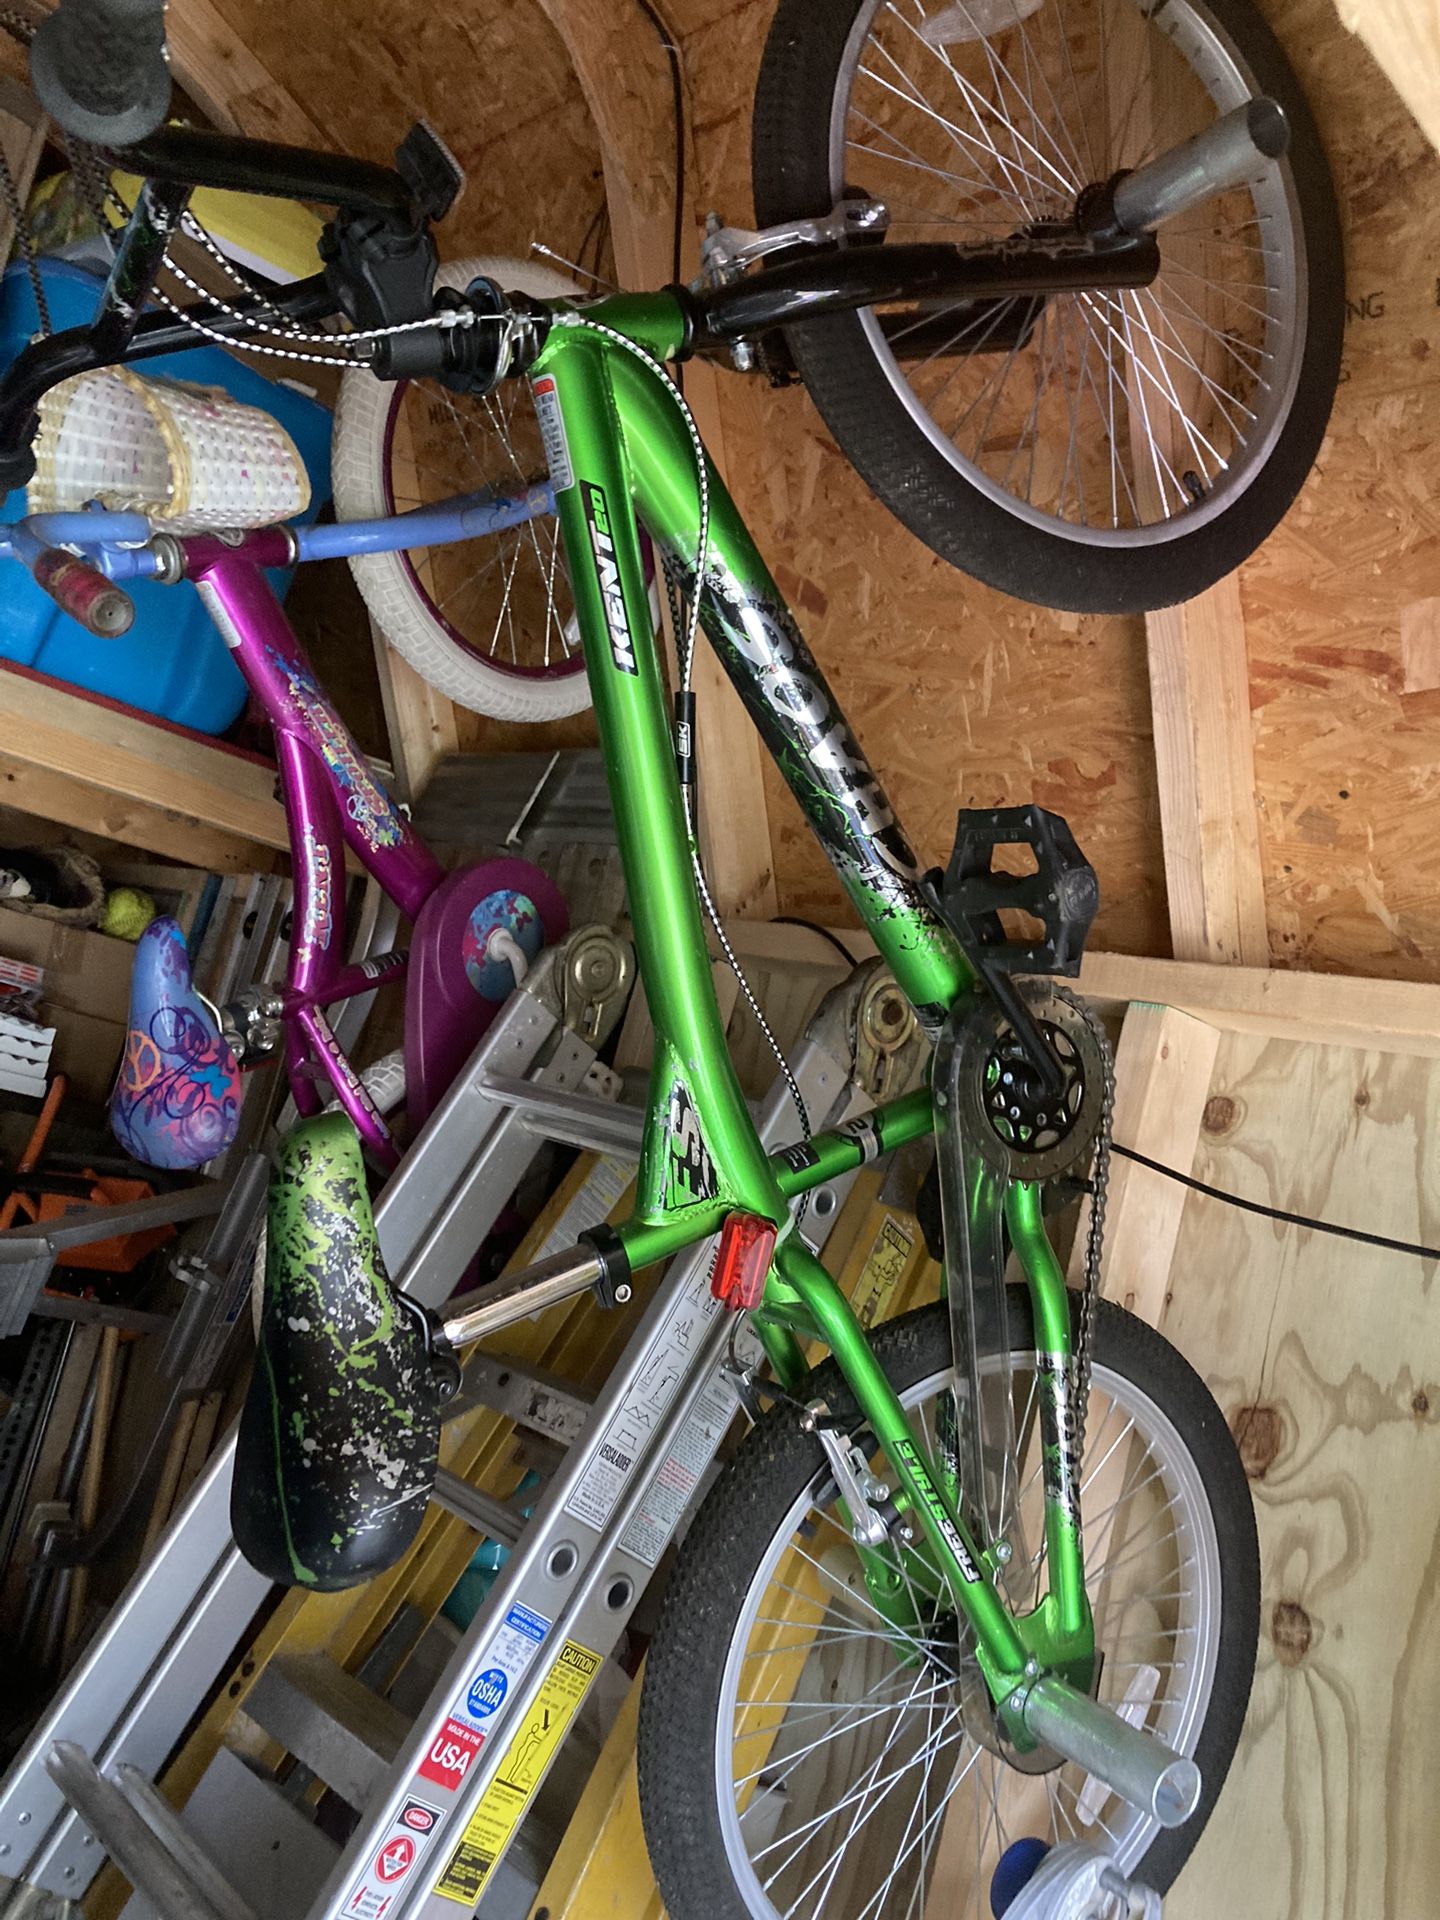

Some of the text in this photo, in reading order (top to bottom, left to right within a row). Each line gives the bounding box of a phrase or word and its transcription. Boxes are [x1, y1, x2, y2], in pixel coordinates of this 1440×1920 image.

[562, 1648, 595, 1673] CAUTION
[472, 1679, 503, 1708] OSHA
[446, 1722, 466, 1737] MADE
[469, 1734, 482, 1745] THE
[430, 1737, 470, 1775] USA
